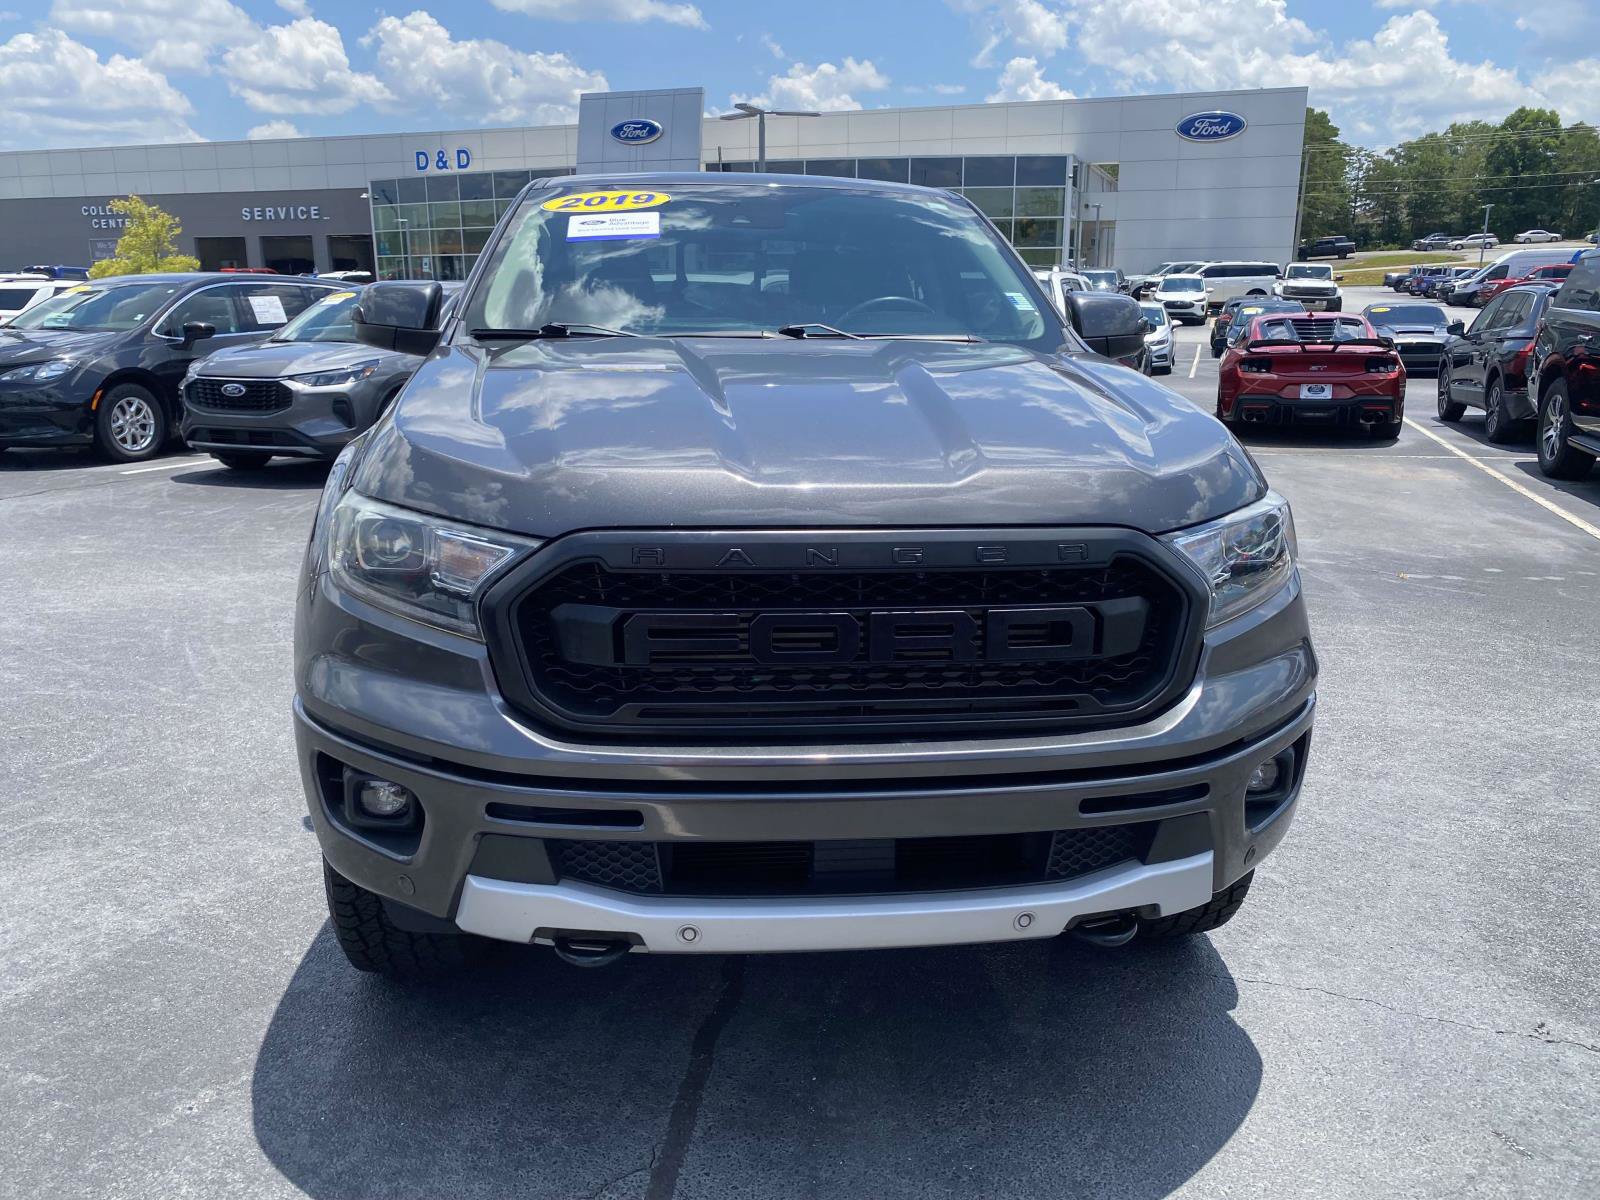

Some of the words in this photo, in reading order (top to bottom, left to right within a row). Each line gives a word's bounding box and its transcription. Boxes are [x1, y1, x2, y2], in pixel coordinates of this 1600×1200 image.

[620, 123, 649, 138] Ford
[1190, 118, 1231, 136] Ford
[415, 151, 430, 171] D
[435, 150, 449, 170] &
[456, 149, 471, 169] D
[556, 193, 656, 209] 2019
[241, 206, 320, 220] SERVICE
[632, 543, 1089, 567] RANGER
[623, 607, 1096, 665] FORD
